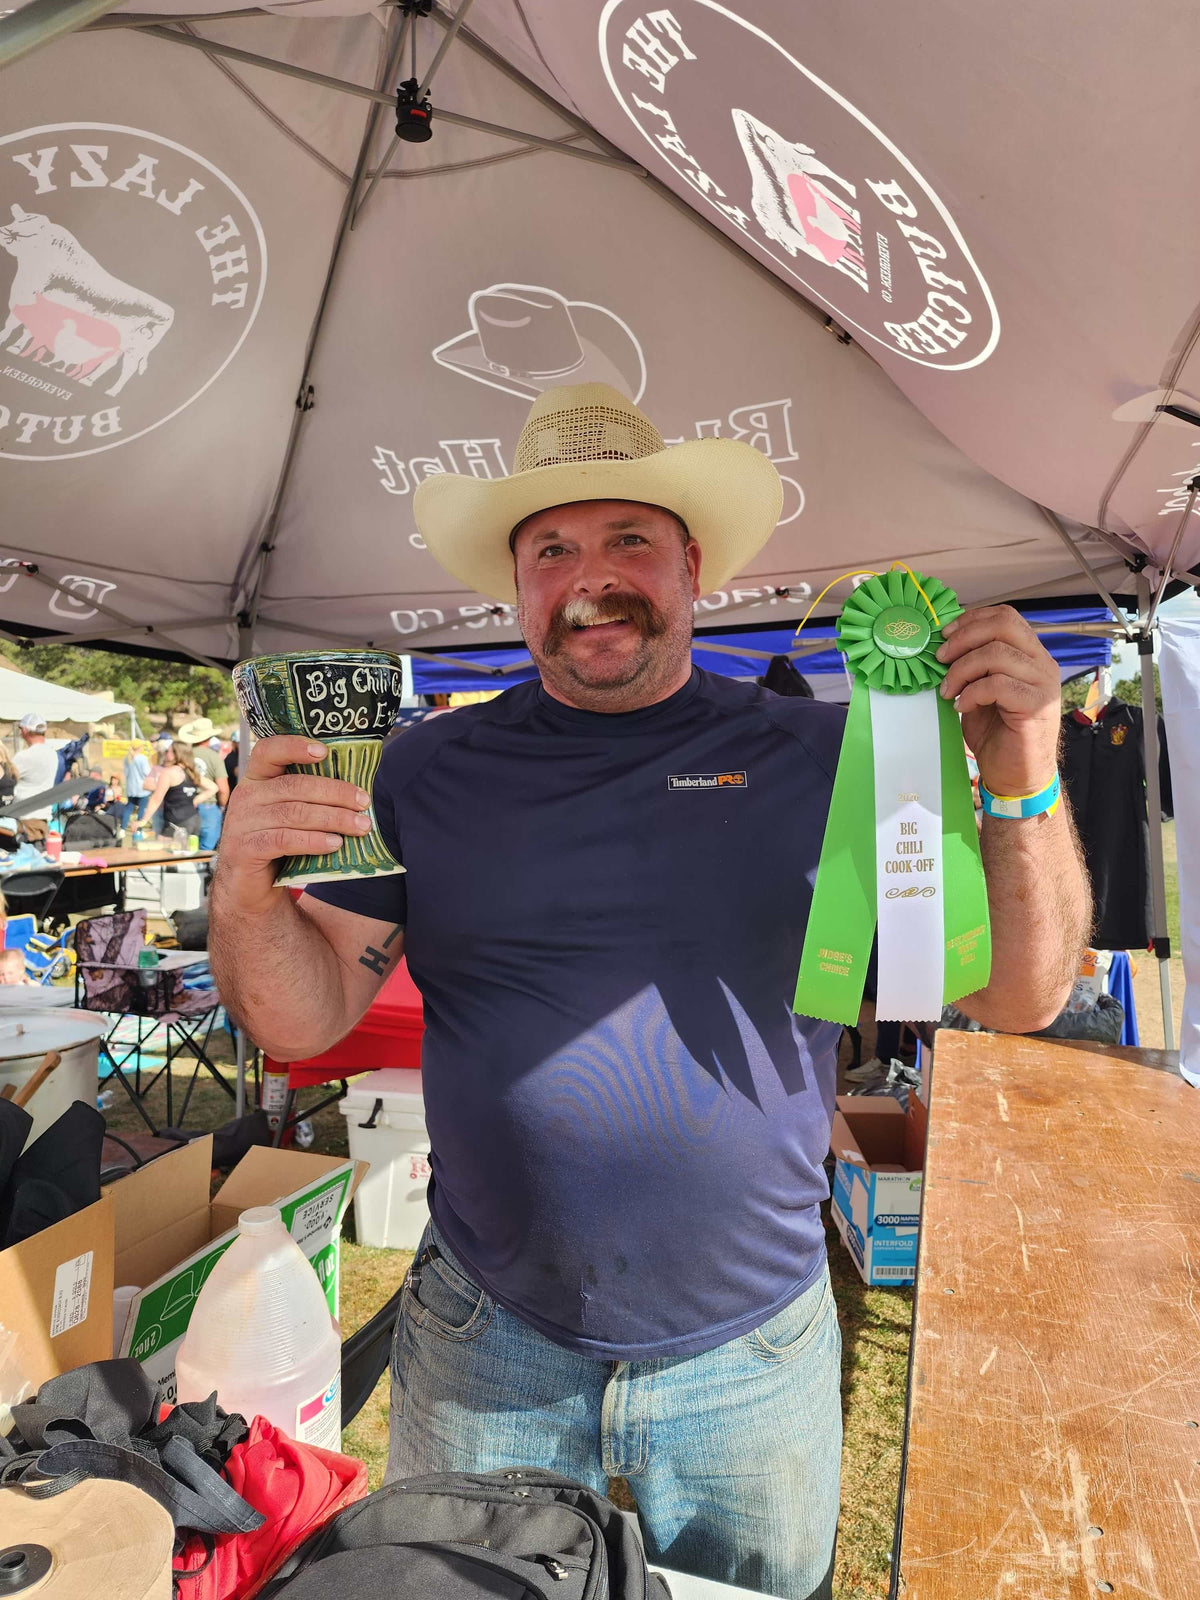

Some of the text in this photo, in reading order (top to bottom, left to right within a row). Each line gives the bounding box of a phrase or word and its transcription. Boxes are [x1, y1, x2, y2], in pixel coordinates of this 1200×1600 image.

[306, 665, 348, 708] Big
[352, 667, 387, 695] Chili
[309, 706, 368, 735] 2026
[670, 776, 718, 787] Timberland
[900, 821, 918, 836] BIG
[896, 840, 923, 855] CHILI
[885, 858, 935, 874] COOK-OFF
[819, 962, 850, 977] CHOICE
[302, 1193, 334, 1220] SERVICE
[877, 1215, 900, 1225] 3000
[873, 1240, 914, 1248] INTERFOLD
